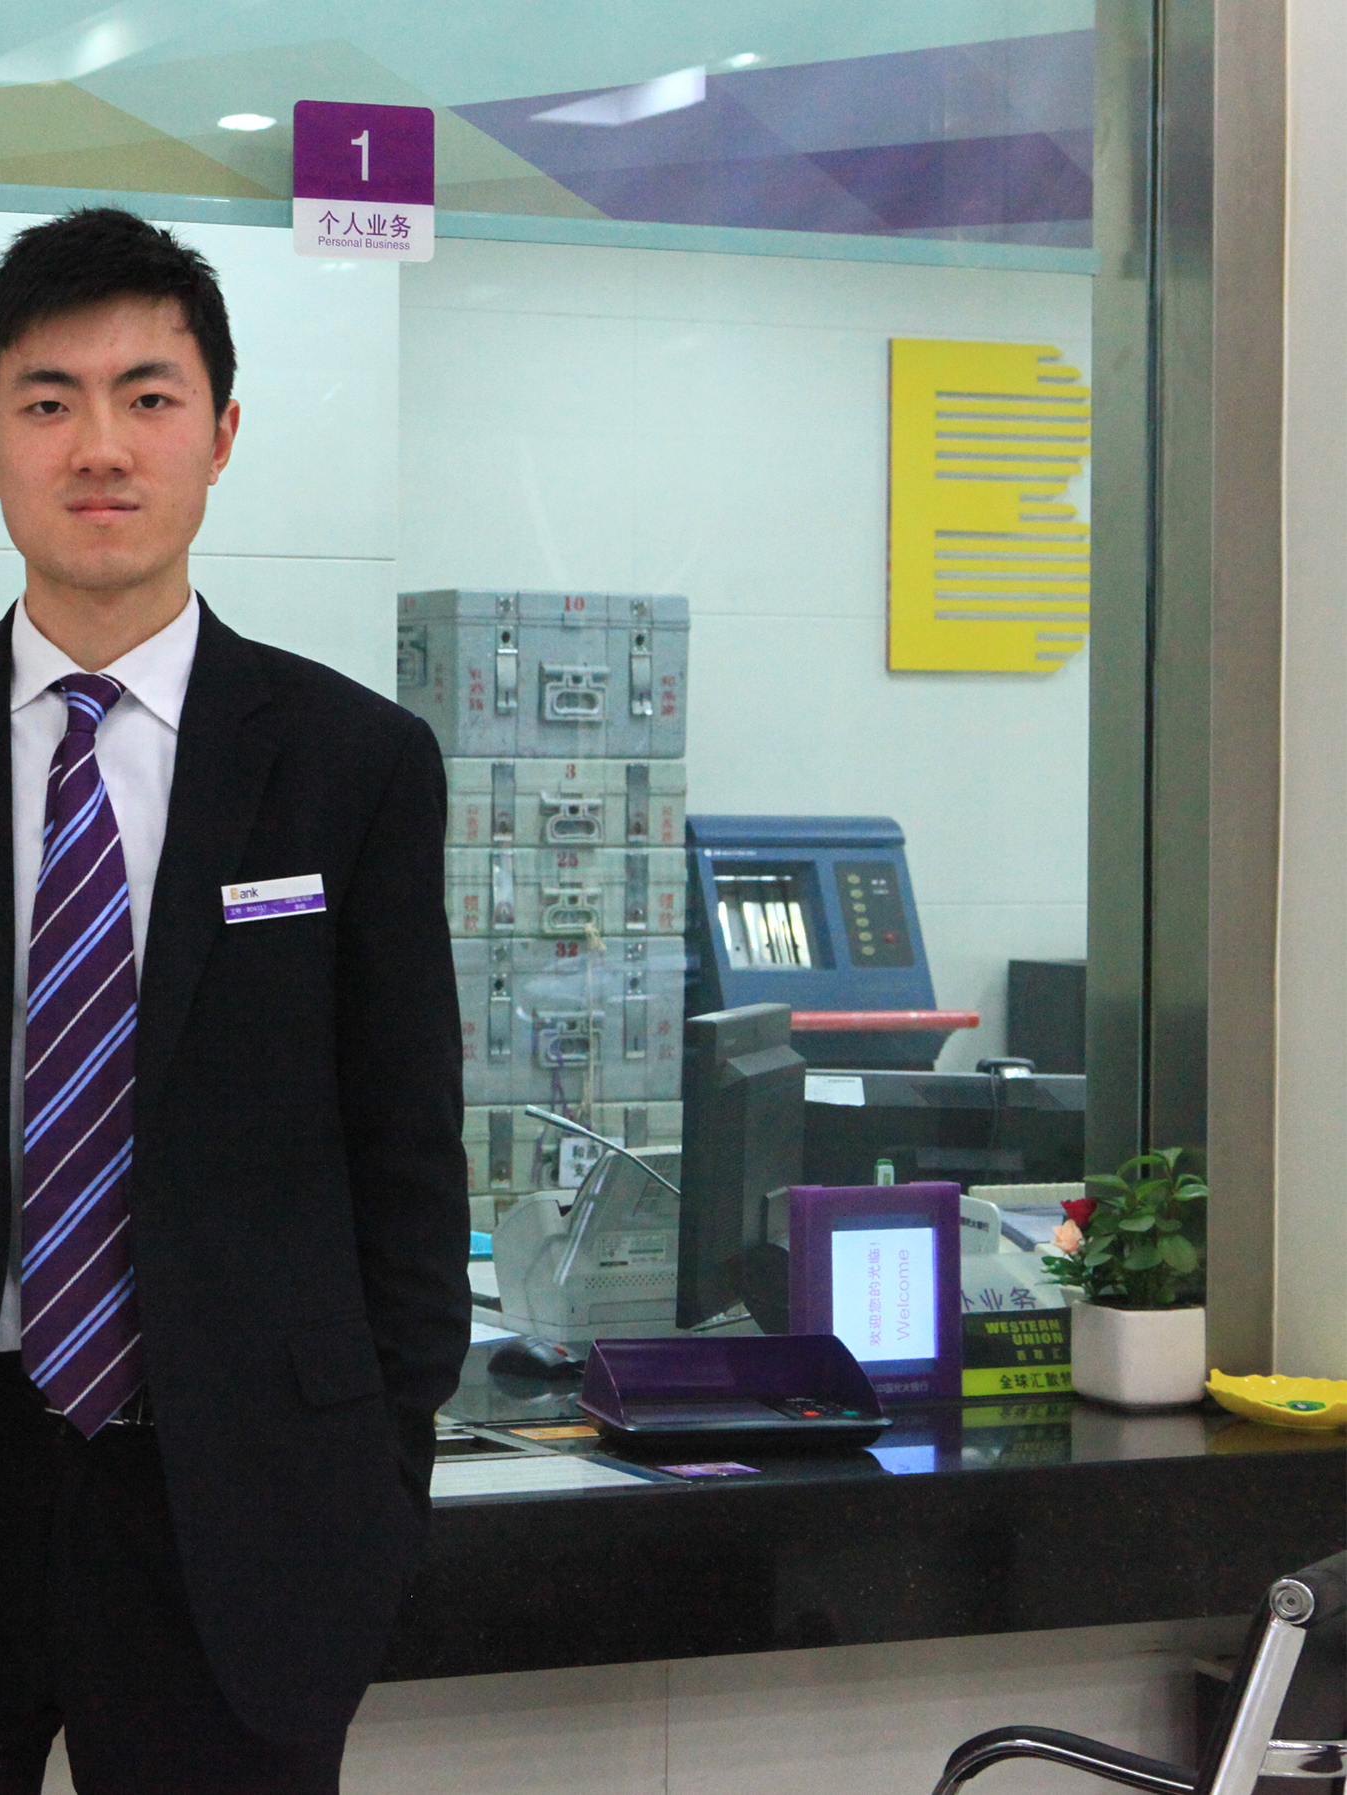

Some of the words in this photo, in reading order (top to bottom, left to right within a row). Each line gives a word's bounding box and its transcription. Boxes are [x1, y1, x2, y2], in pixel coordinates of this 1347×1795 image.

[351, 130, 368, 181] 1
[319, 210, 411, 238] 个人业务
[318, 235, 363, 248] Personal
[365, 237, 411, 251] Business
[564, 596, 586, 612] 10
[230, 887, 259, 901] Bank
[896, 1249, 911, 1341] Welcome
[985, 1319, 1061, 1334] WESTERN
[1012, 1332, 1064, 1346] UNION
